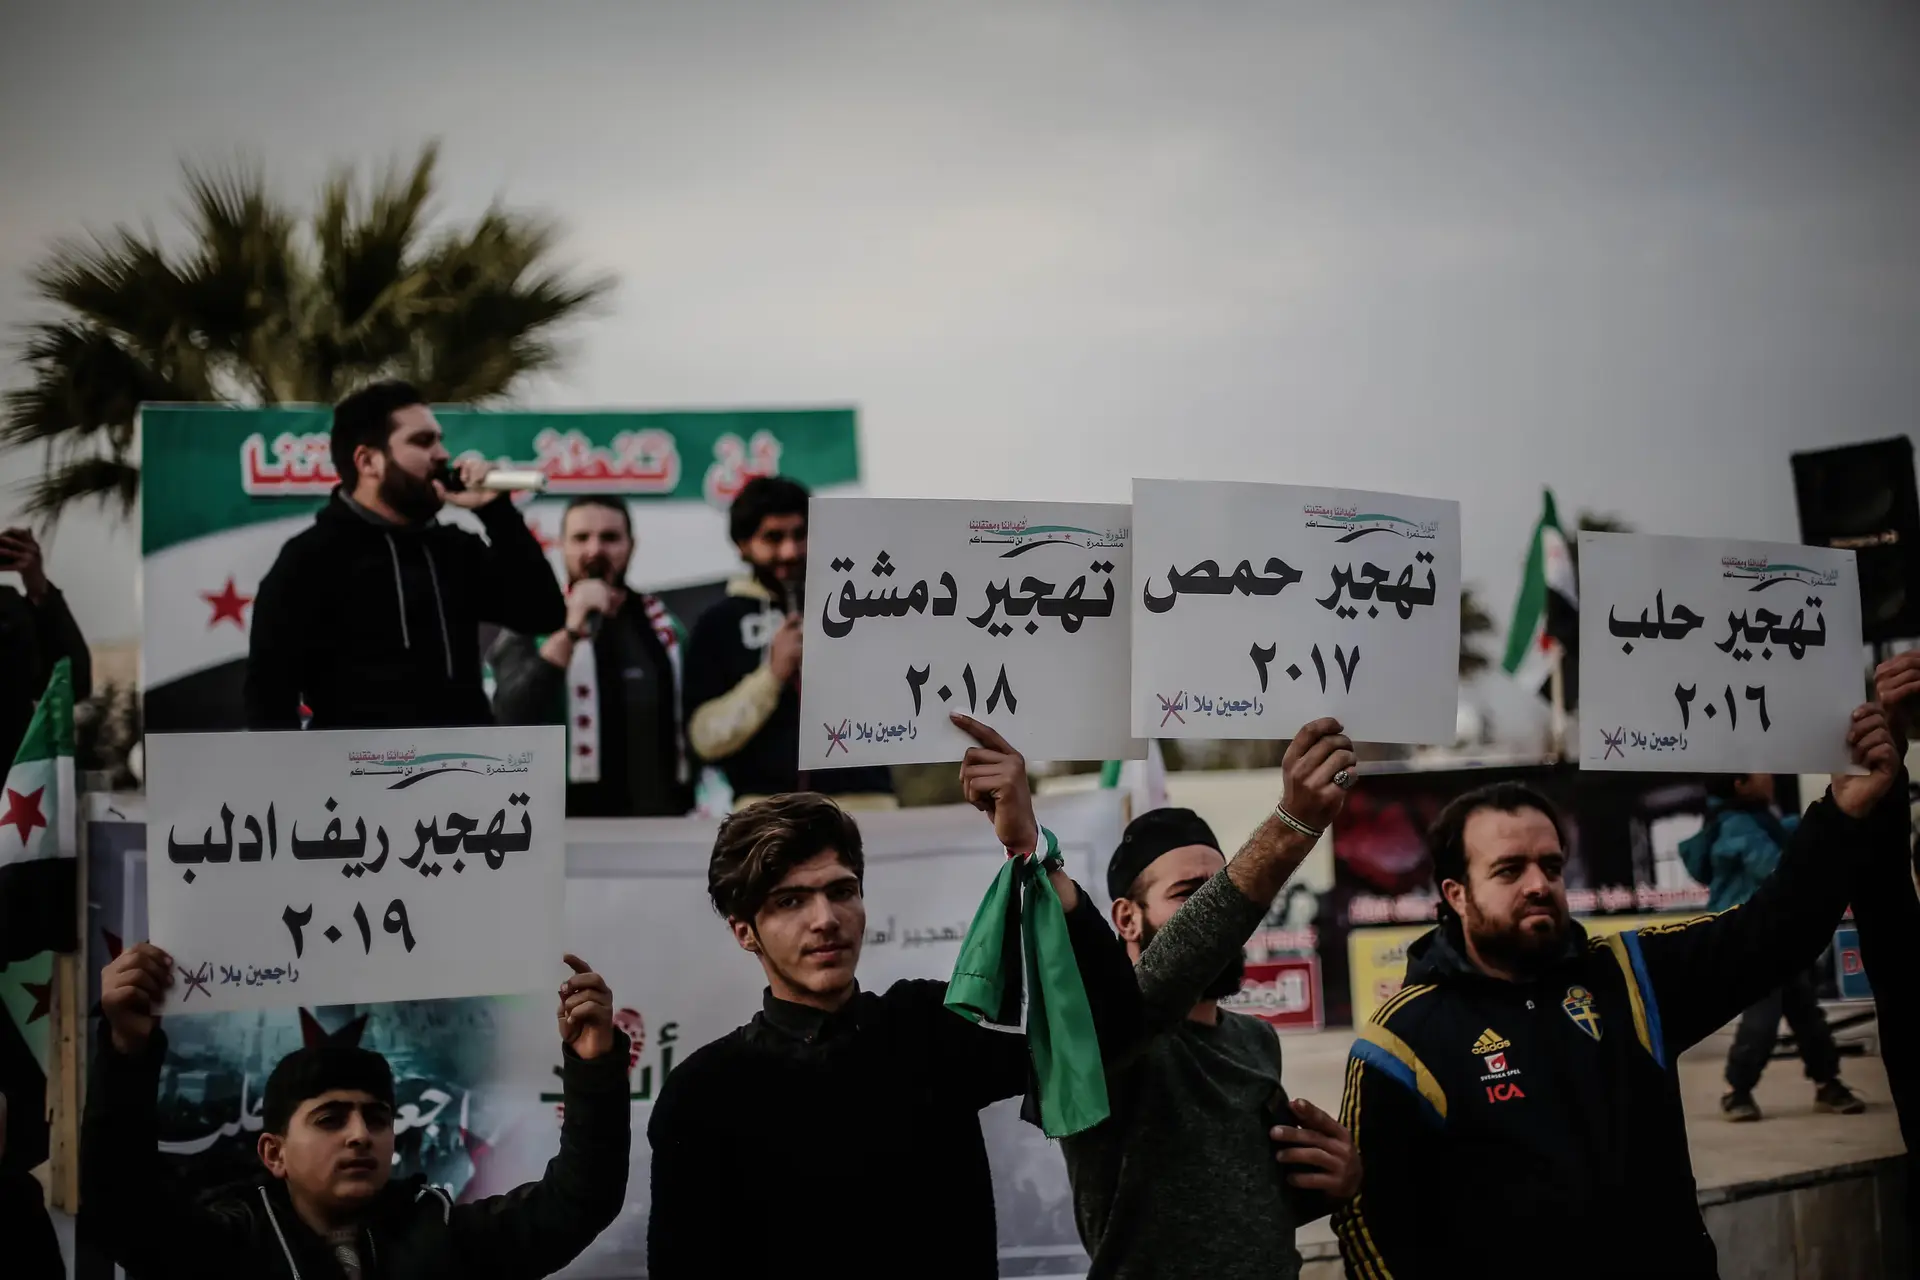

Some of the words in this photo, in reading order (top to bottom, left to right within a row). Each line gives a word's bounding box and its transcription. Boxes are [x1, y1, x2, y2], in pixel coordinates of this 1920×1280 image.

[1015, 536, 1023, 546] لن
[1087, 538, 1124, 549] مستمرة
[822, 550, 958, 639] دمشق
[1143, 557, 1303, 613] حمص
[1316, 551, 1436, 620] تهجير
[966, 560, 1115, 637] تهجير
[1608, 588, 1705, 655] حلب
[1714, 595, 1827, 662] تهجير
[1249, 641, 1360, 694] ٢٠١٧
[905, 662, 1018, 717] ٢٠١٨
[1193, 695, 1213, 717] بلا
[1216, 696, 1264, 717] راجعين
[1674, 682, 1771, 732] ٢٠١٦
[856, 722, 873, 743] بلا
[876, 720, 917, 743] راجعين
[1631, 731, 1647, 750] بلا
[1650, 732, 1688, 751] راجعين
[404, 767, 413, 776] لن
[486, 765, 528, 776] مستمرة
[167, 801, 278, 885] ادلب
[291, 796, 390, 879] ريف
[398, 791, 532, 878] تهجير
[281, 898, 417, 959] ٢٠١٩
[220, 965, 242, 987] بلا
[246, 962, 299, 986] راجعين
[1471, 1039, 1511, 1054] adidas
[1480, 1072, 1506, 1081] SVENSKA
[1507, 1068, 1521, 1077] SPEL
[1486, 1083, 1525, 1103] ICA
